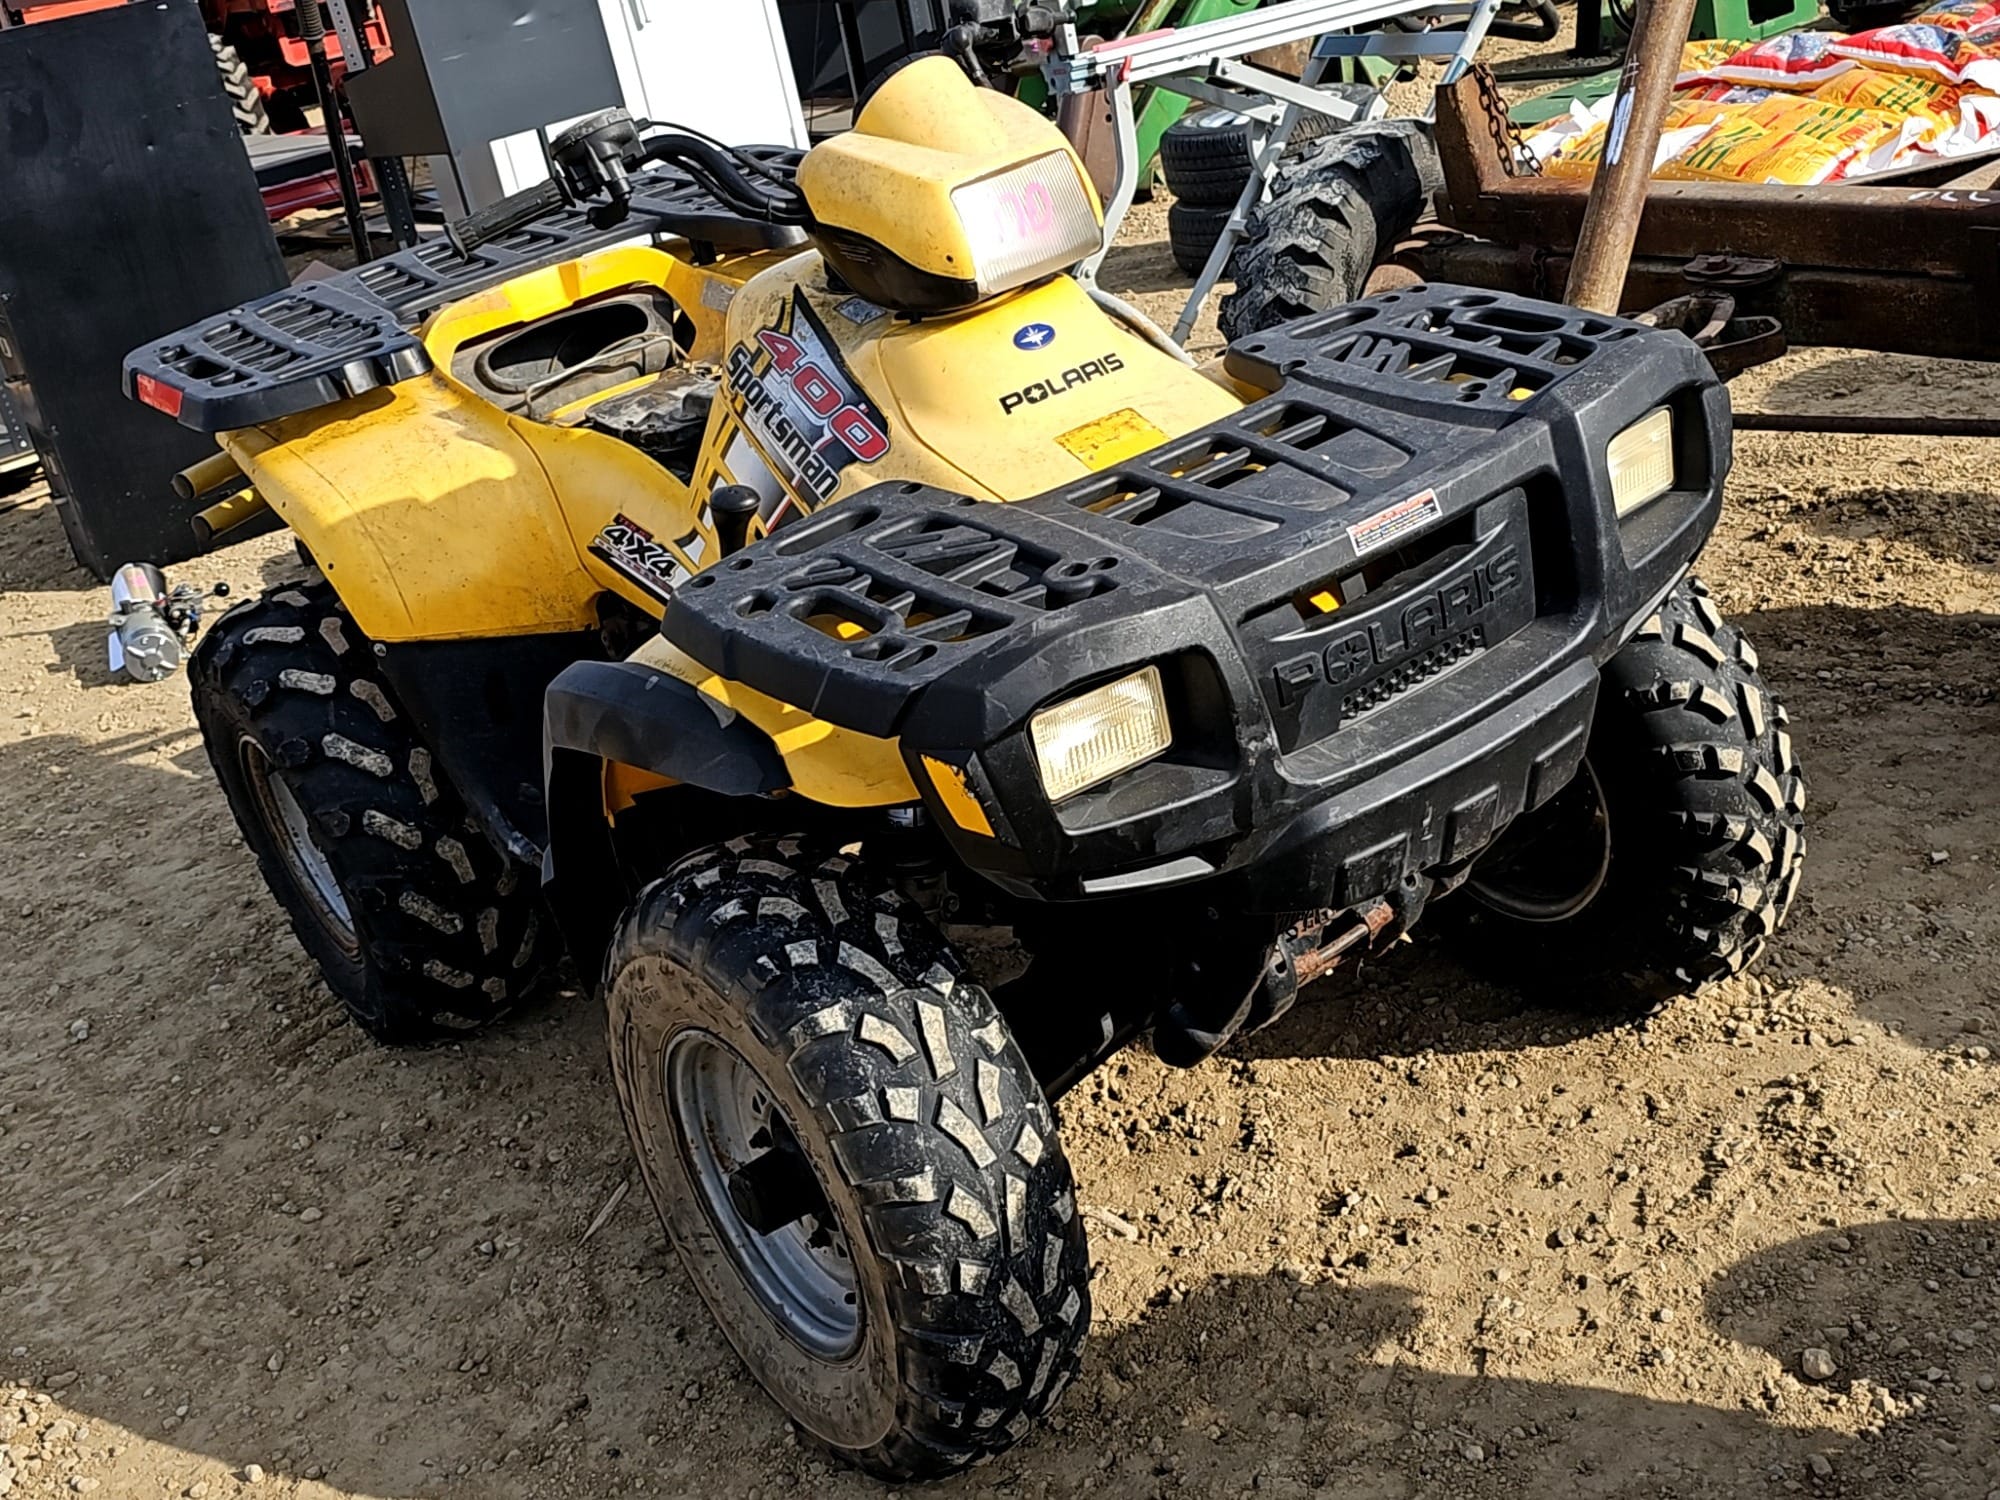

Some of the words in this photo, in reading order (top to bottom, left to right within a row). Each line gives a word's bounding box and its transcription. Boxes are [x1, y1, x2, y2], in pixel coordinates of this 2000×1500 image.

[727, 344, 841, 501] Sportsman
[756, 331, 889, 462] 400
[998, 351, 1126, 415] POLARIS
[1271, 543, 1523, 709] POLARIS
